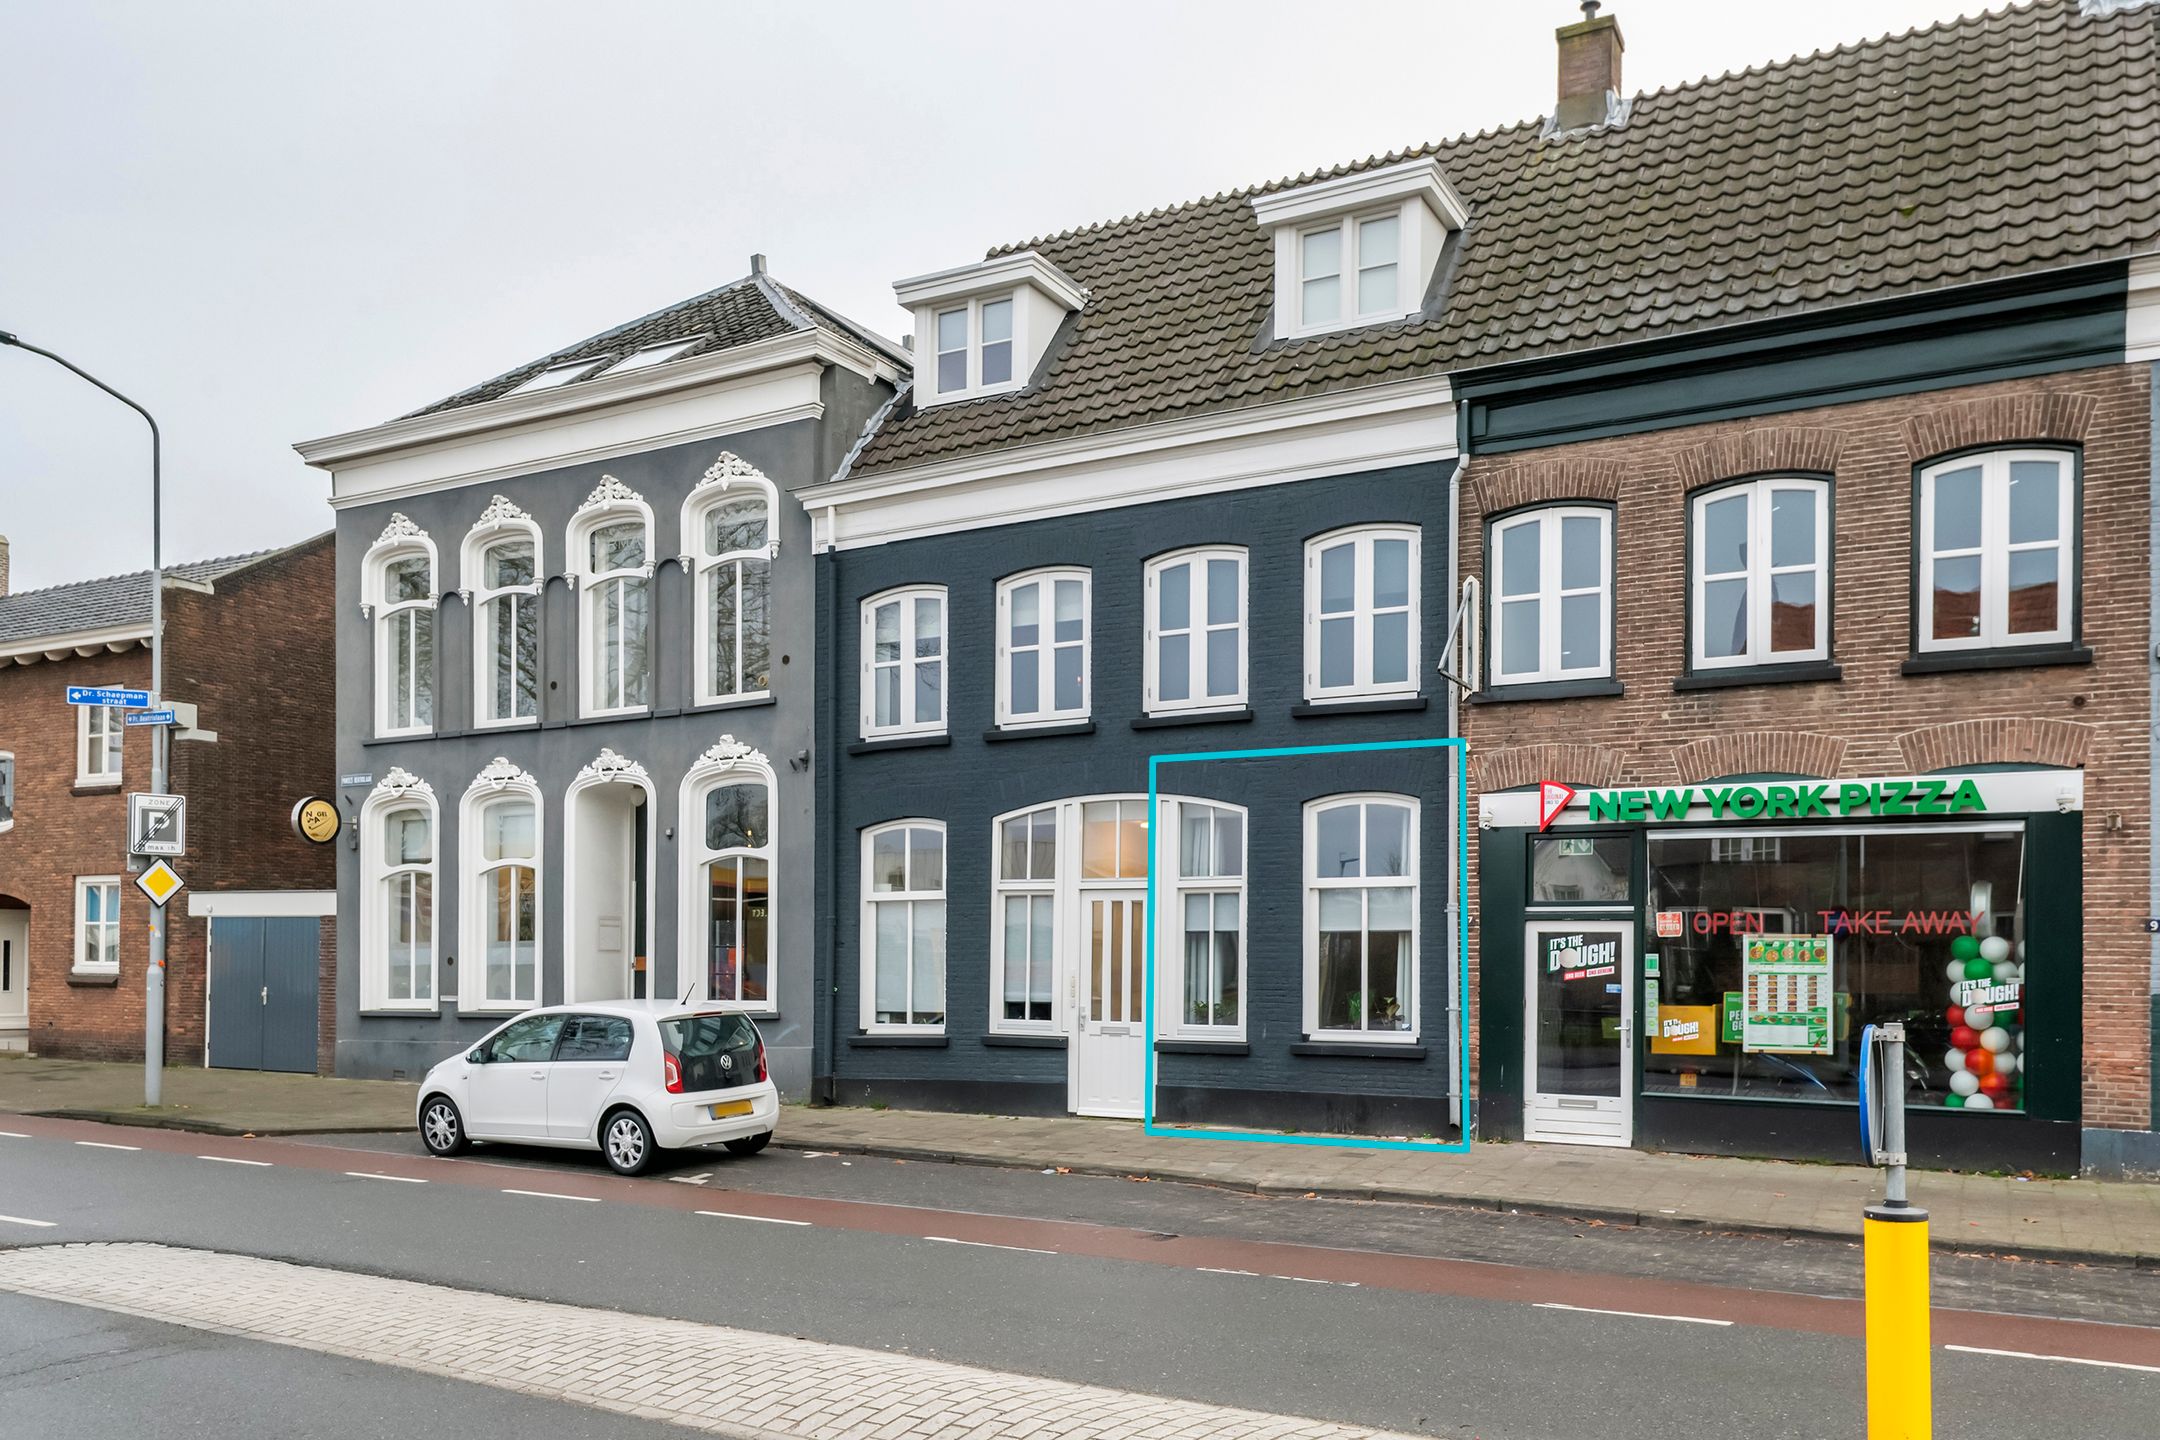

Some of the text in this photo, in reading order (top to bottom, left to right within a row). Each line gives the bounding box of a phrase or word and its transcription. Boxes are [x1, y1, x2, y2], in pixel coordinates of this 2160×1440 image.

[96, 690, 147, 700] Schaepman-
[1589, 779, 1988, 821] NEW YORK PIZZA
[1693, 911, 1764, 935] OPEN
[1817, 910, 1985, 935] TAKE AWAY
[2150, 920, 2159, 931] 9
[1550, 934, 1584, 950] IT'S THE
[1549, 941, 1616, 972] DOUGH!
[1962, 977, 1992, 991] IT'S THE
[1962, 983, 2020, 1007] DOUGH!
[1663, 1021, 1699, 1038] DOUGH!
